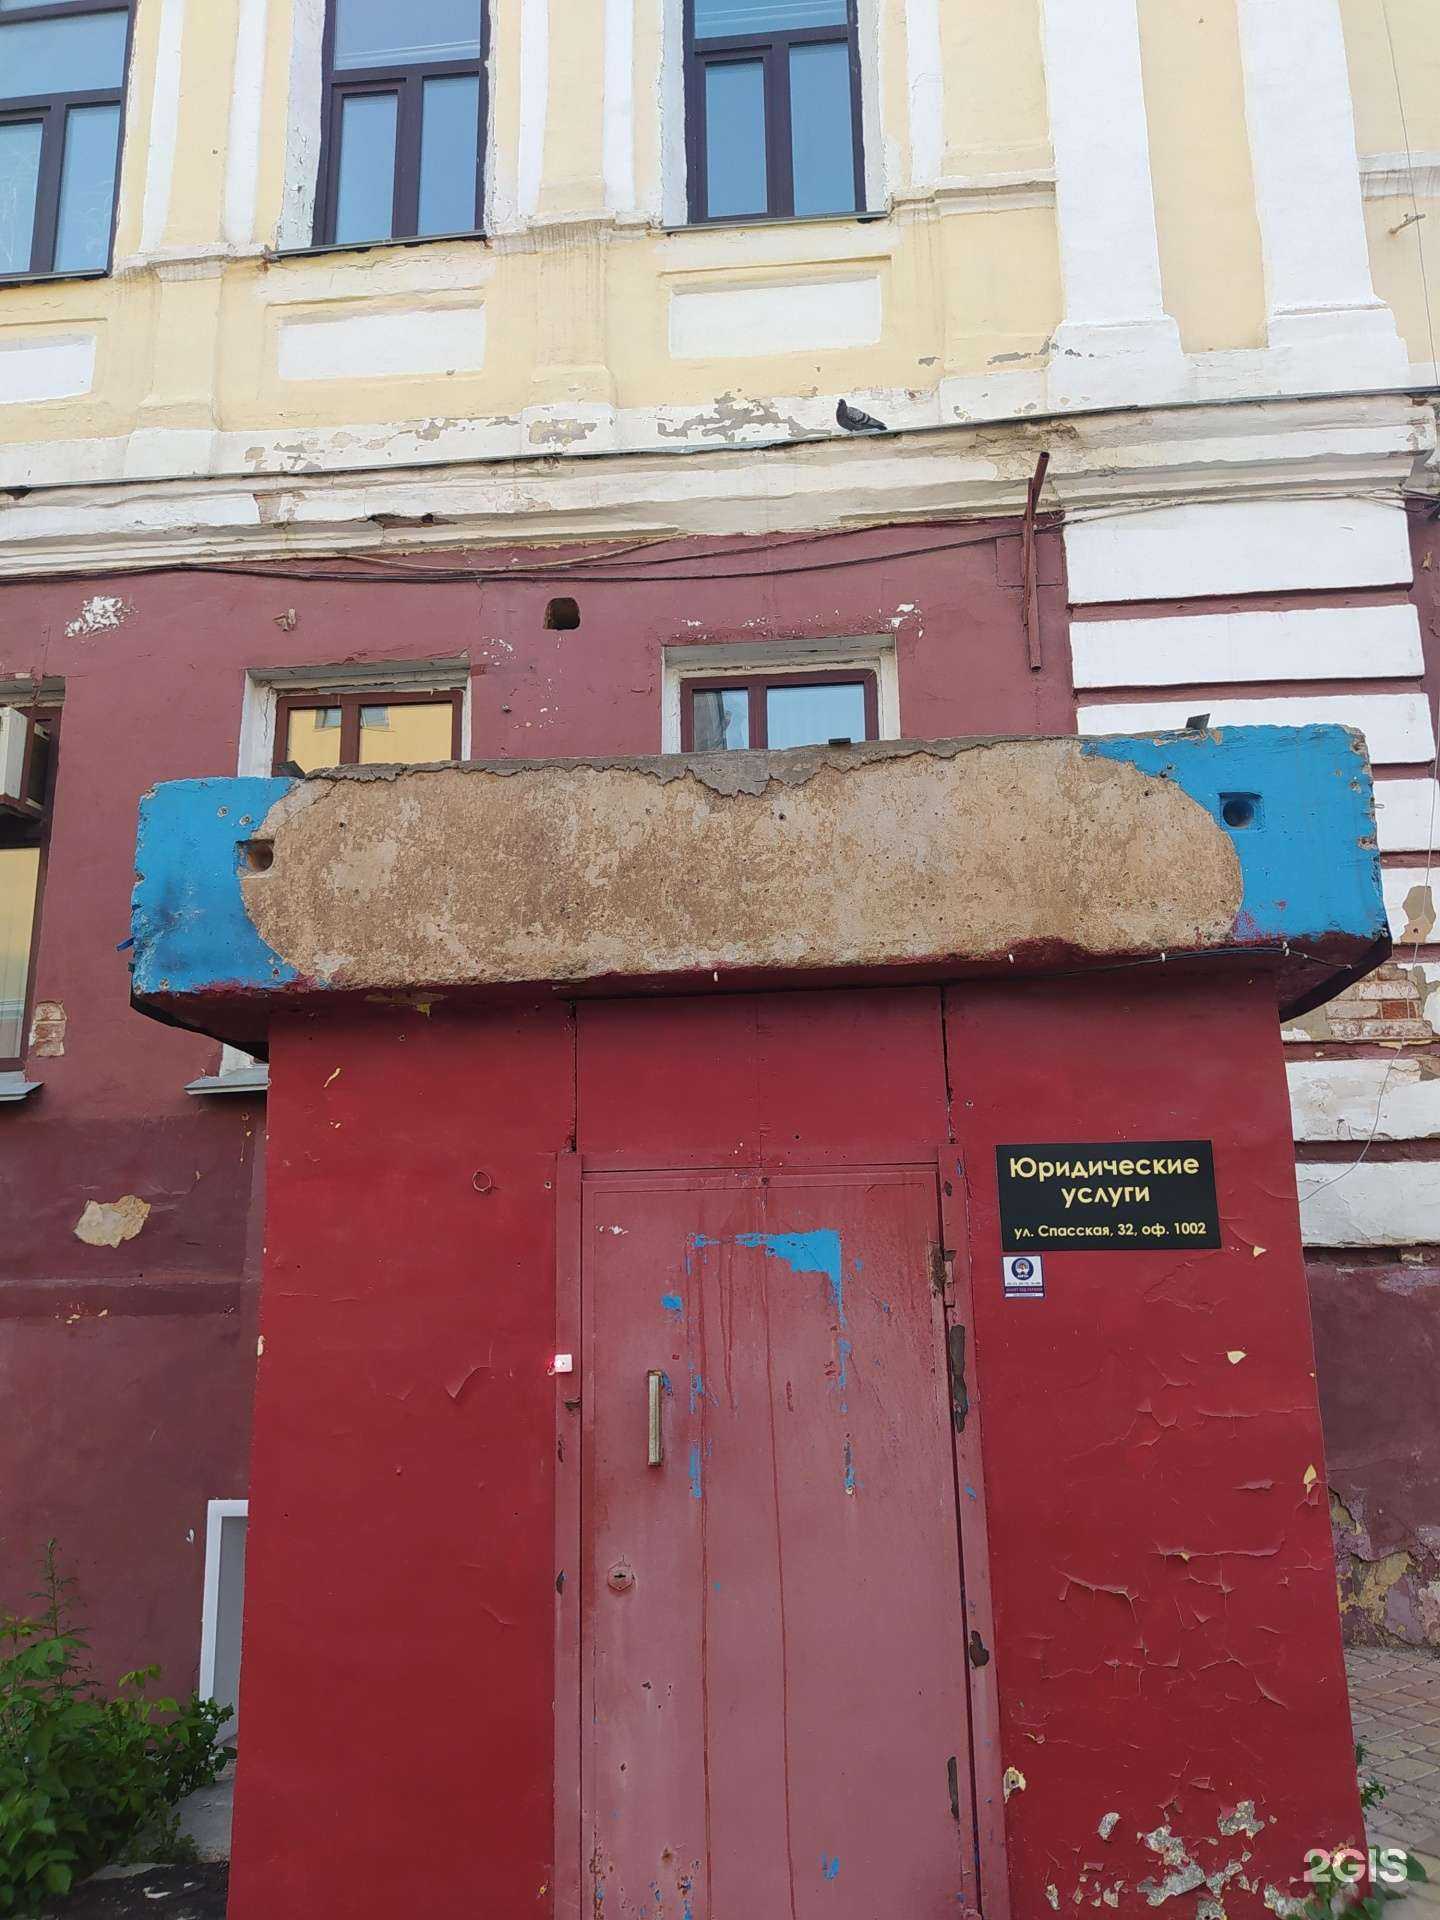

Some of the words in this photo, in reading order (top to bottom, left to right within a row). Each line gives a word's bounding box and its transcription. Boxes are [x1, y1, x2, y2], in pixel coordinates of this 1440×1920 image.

[1009, 1157, 1200, 1182] Юридические
[1060, 1186, 1150, 1208] услуги
[1014, 1227, 1035, 1240] ул.
[1037, 1224, 1114, 1238] Спасская,
[1117, 1223, 1138, 1238] 32,
[1141, 1222, 1170, 1238] оф.
[1173, 1221, 1207, 1236] 1002
